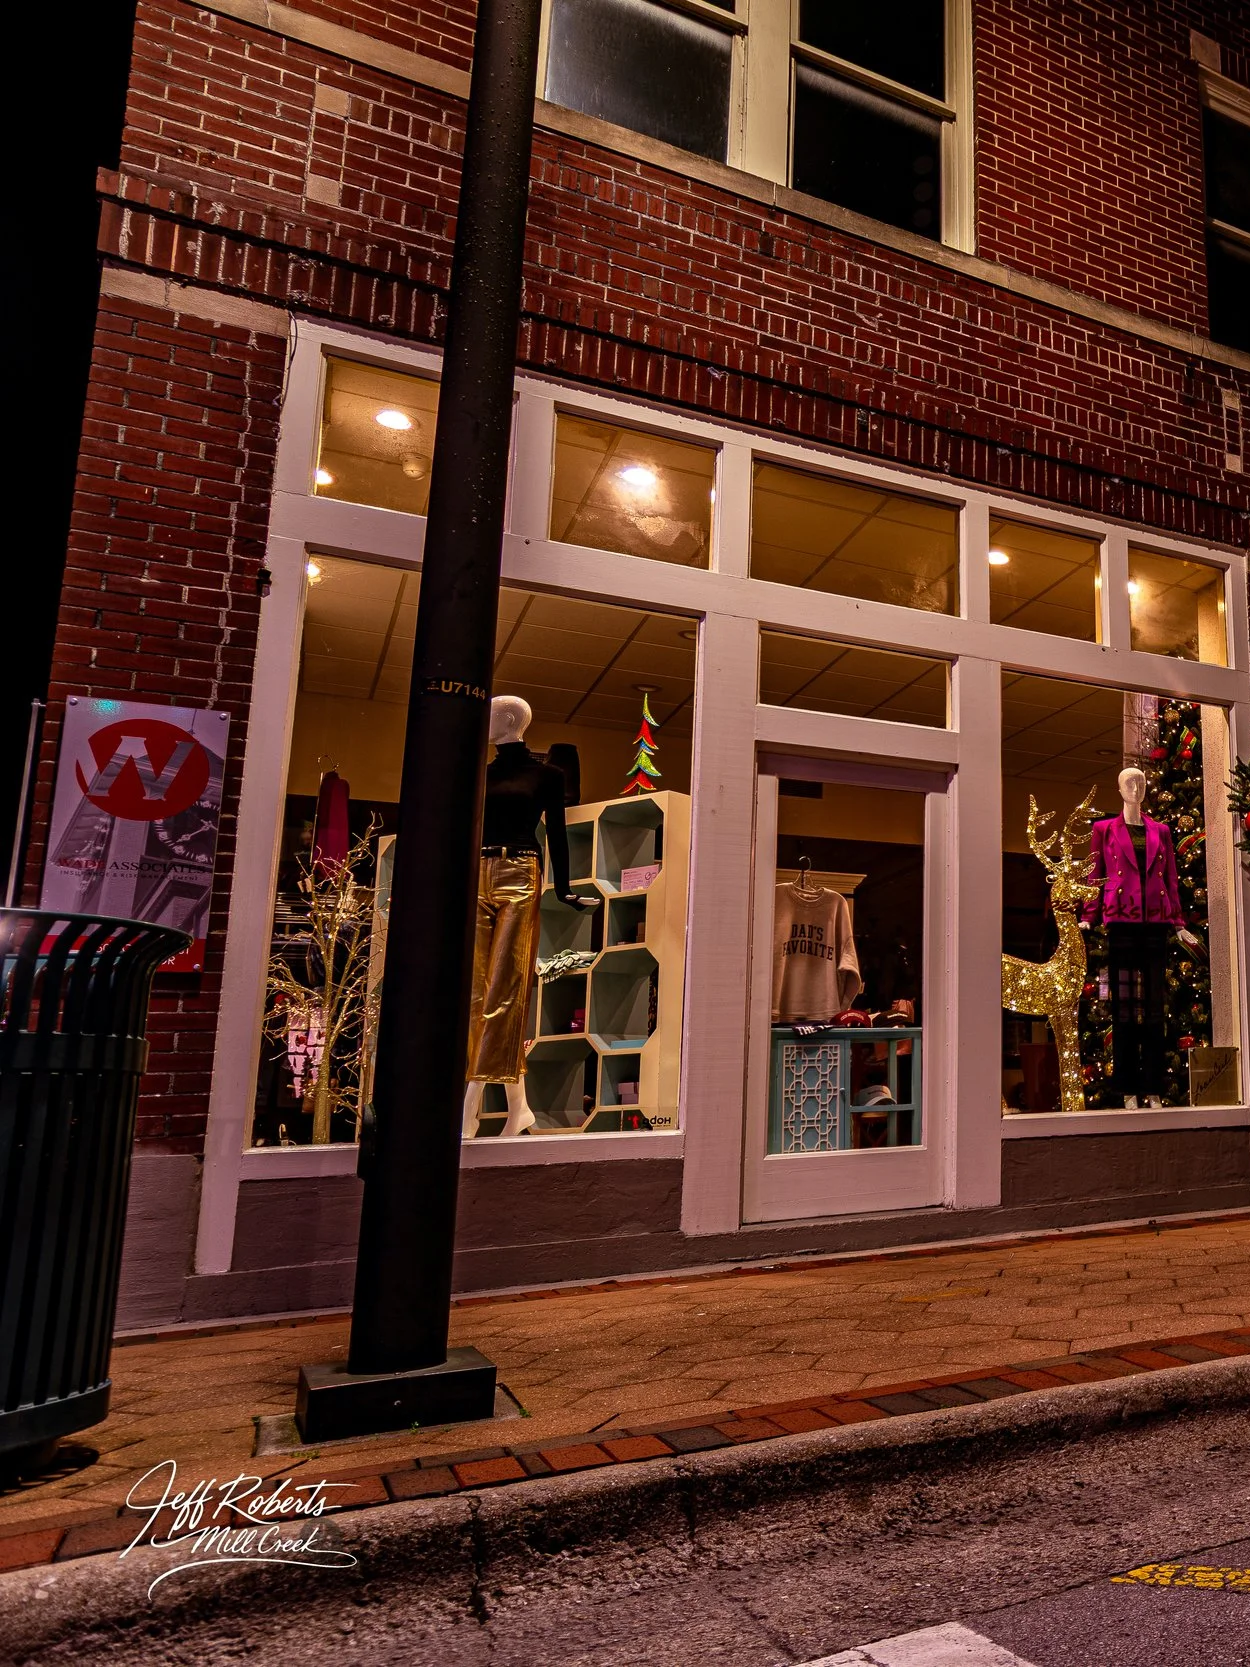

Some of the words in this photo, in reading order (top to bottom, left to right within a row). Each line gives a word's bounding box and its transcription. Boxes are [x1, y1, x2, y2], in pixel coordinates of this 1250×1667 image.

[441, 680, 486, 700] U7144
[109, 861, 206, 874] ASSOCIATES
[791, 924, 825, 941] DAD'S
[782, 939, 834, 961] FAVORITE
[795, 1025, 818, 1036] THE
